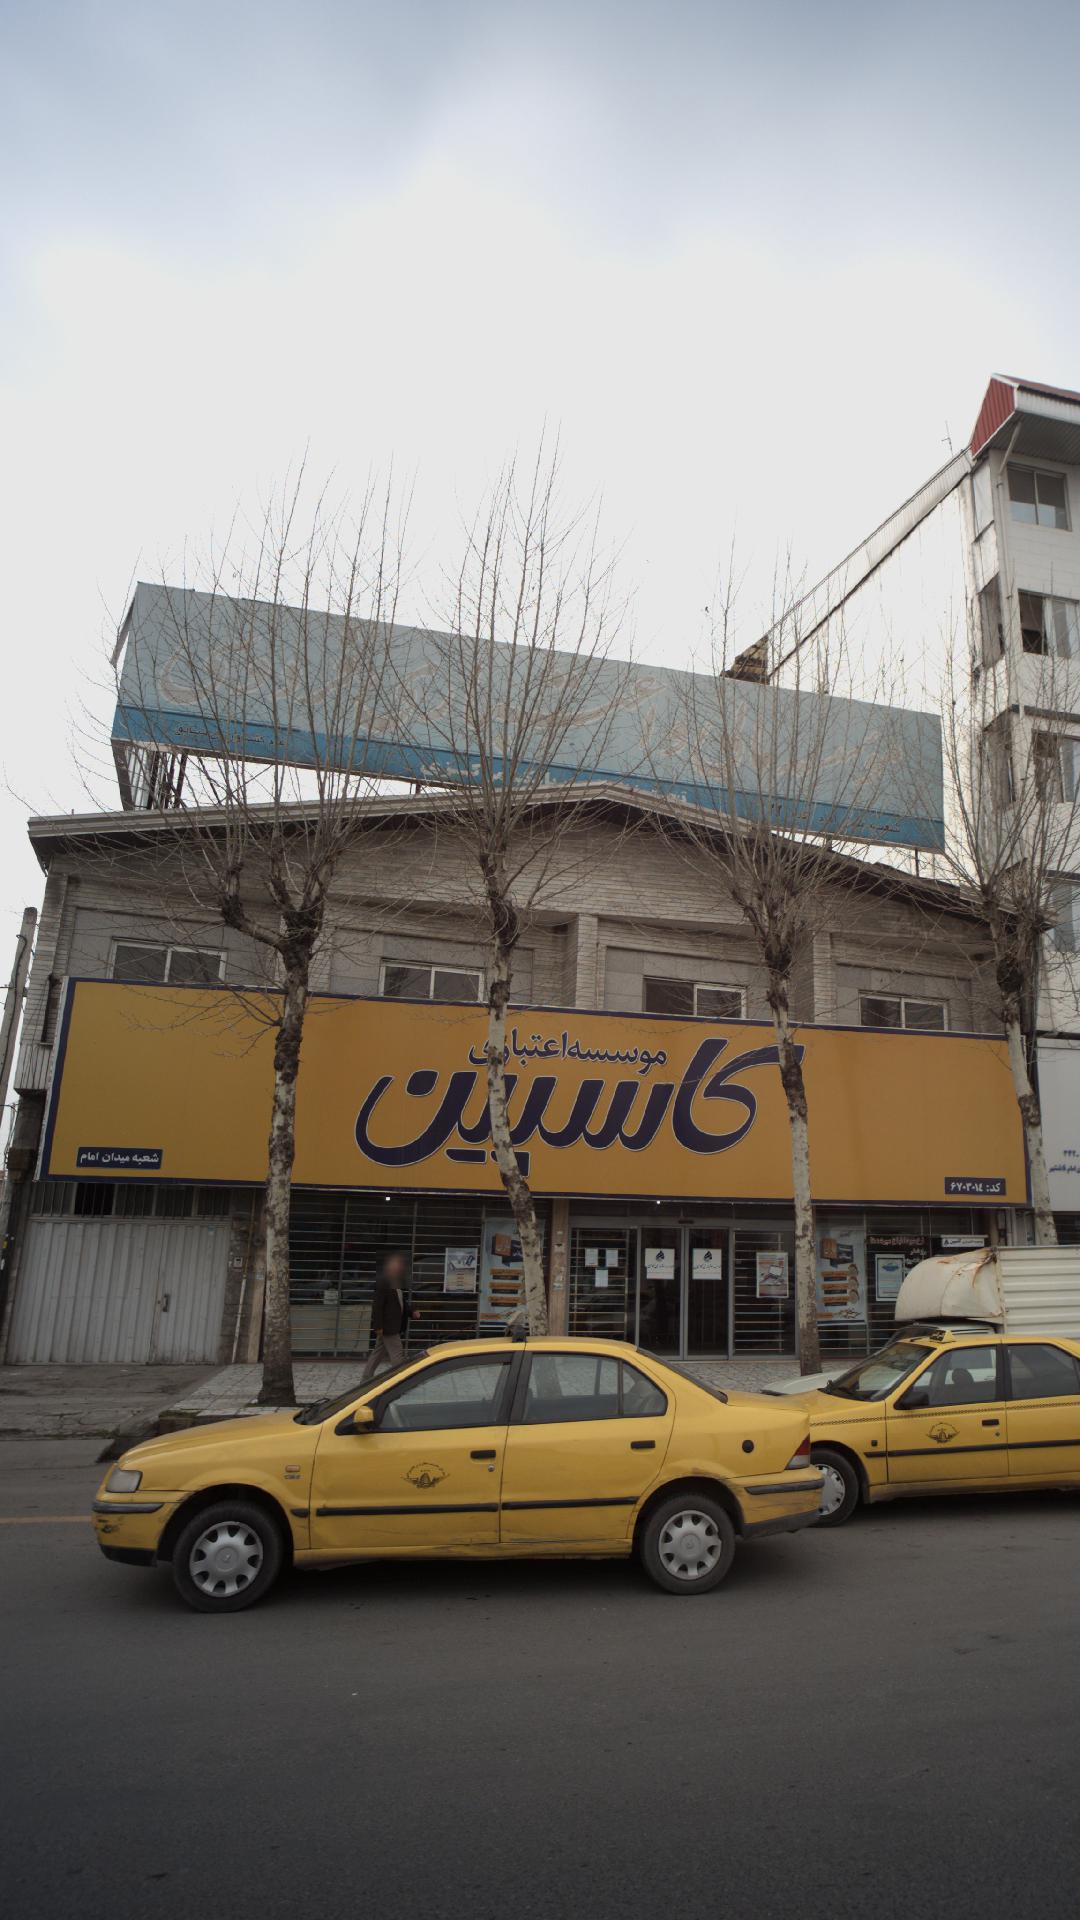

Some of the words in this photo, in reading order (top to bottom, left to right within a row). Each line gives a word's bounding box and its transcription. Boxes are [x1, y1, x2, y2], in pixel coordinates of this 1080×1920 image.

[567, 1039, 668, 1075] موسسه
[355, 1037, 805, 1177] کاسپین
[80, 1151, 100, 1164] امام
[102, 1152, 130, 1164] میدان
[132, 1152, 160, 1165] شعبه
